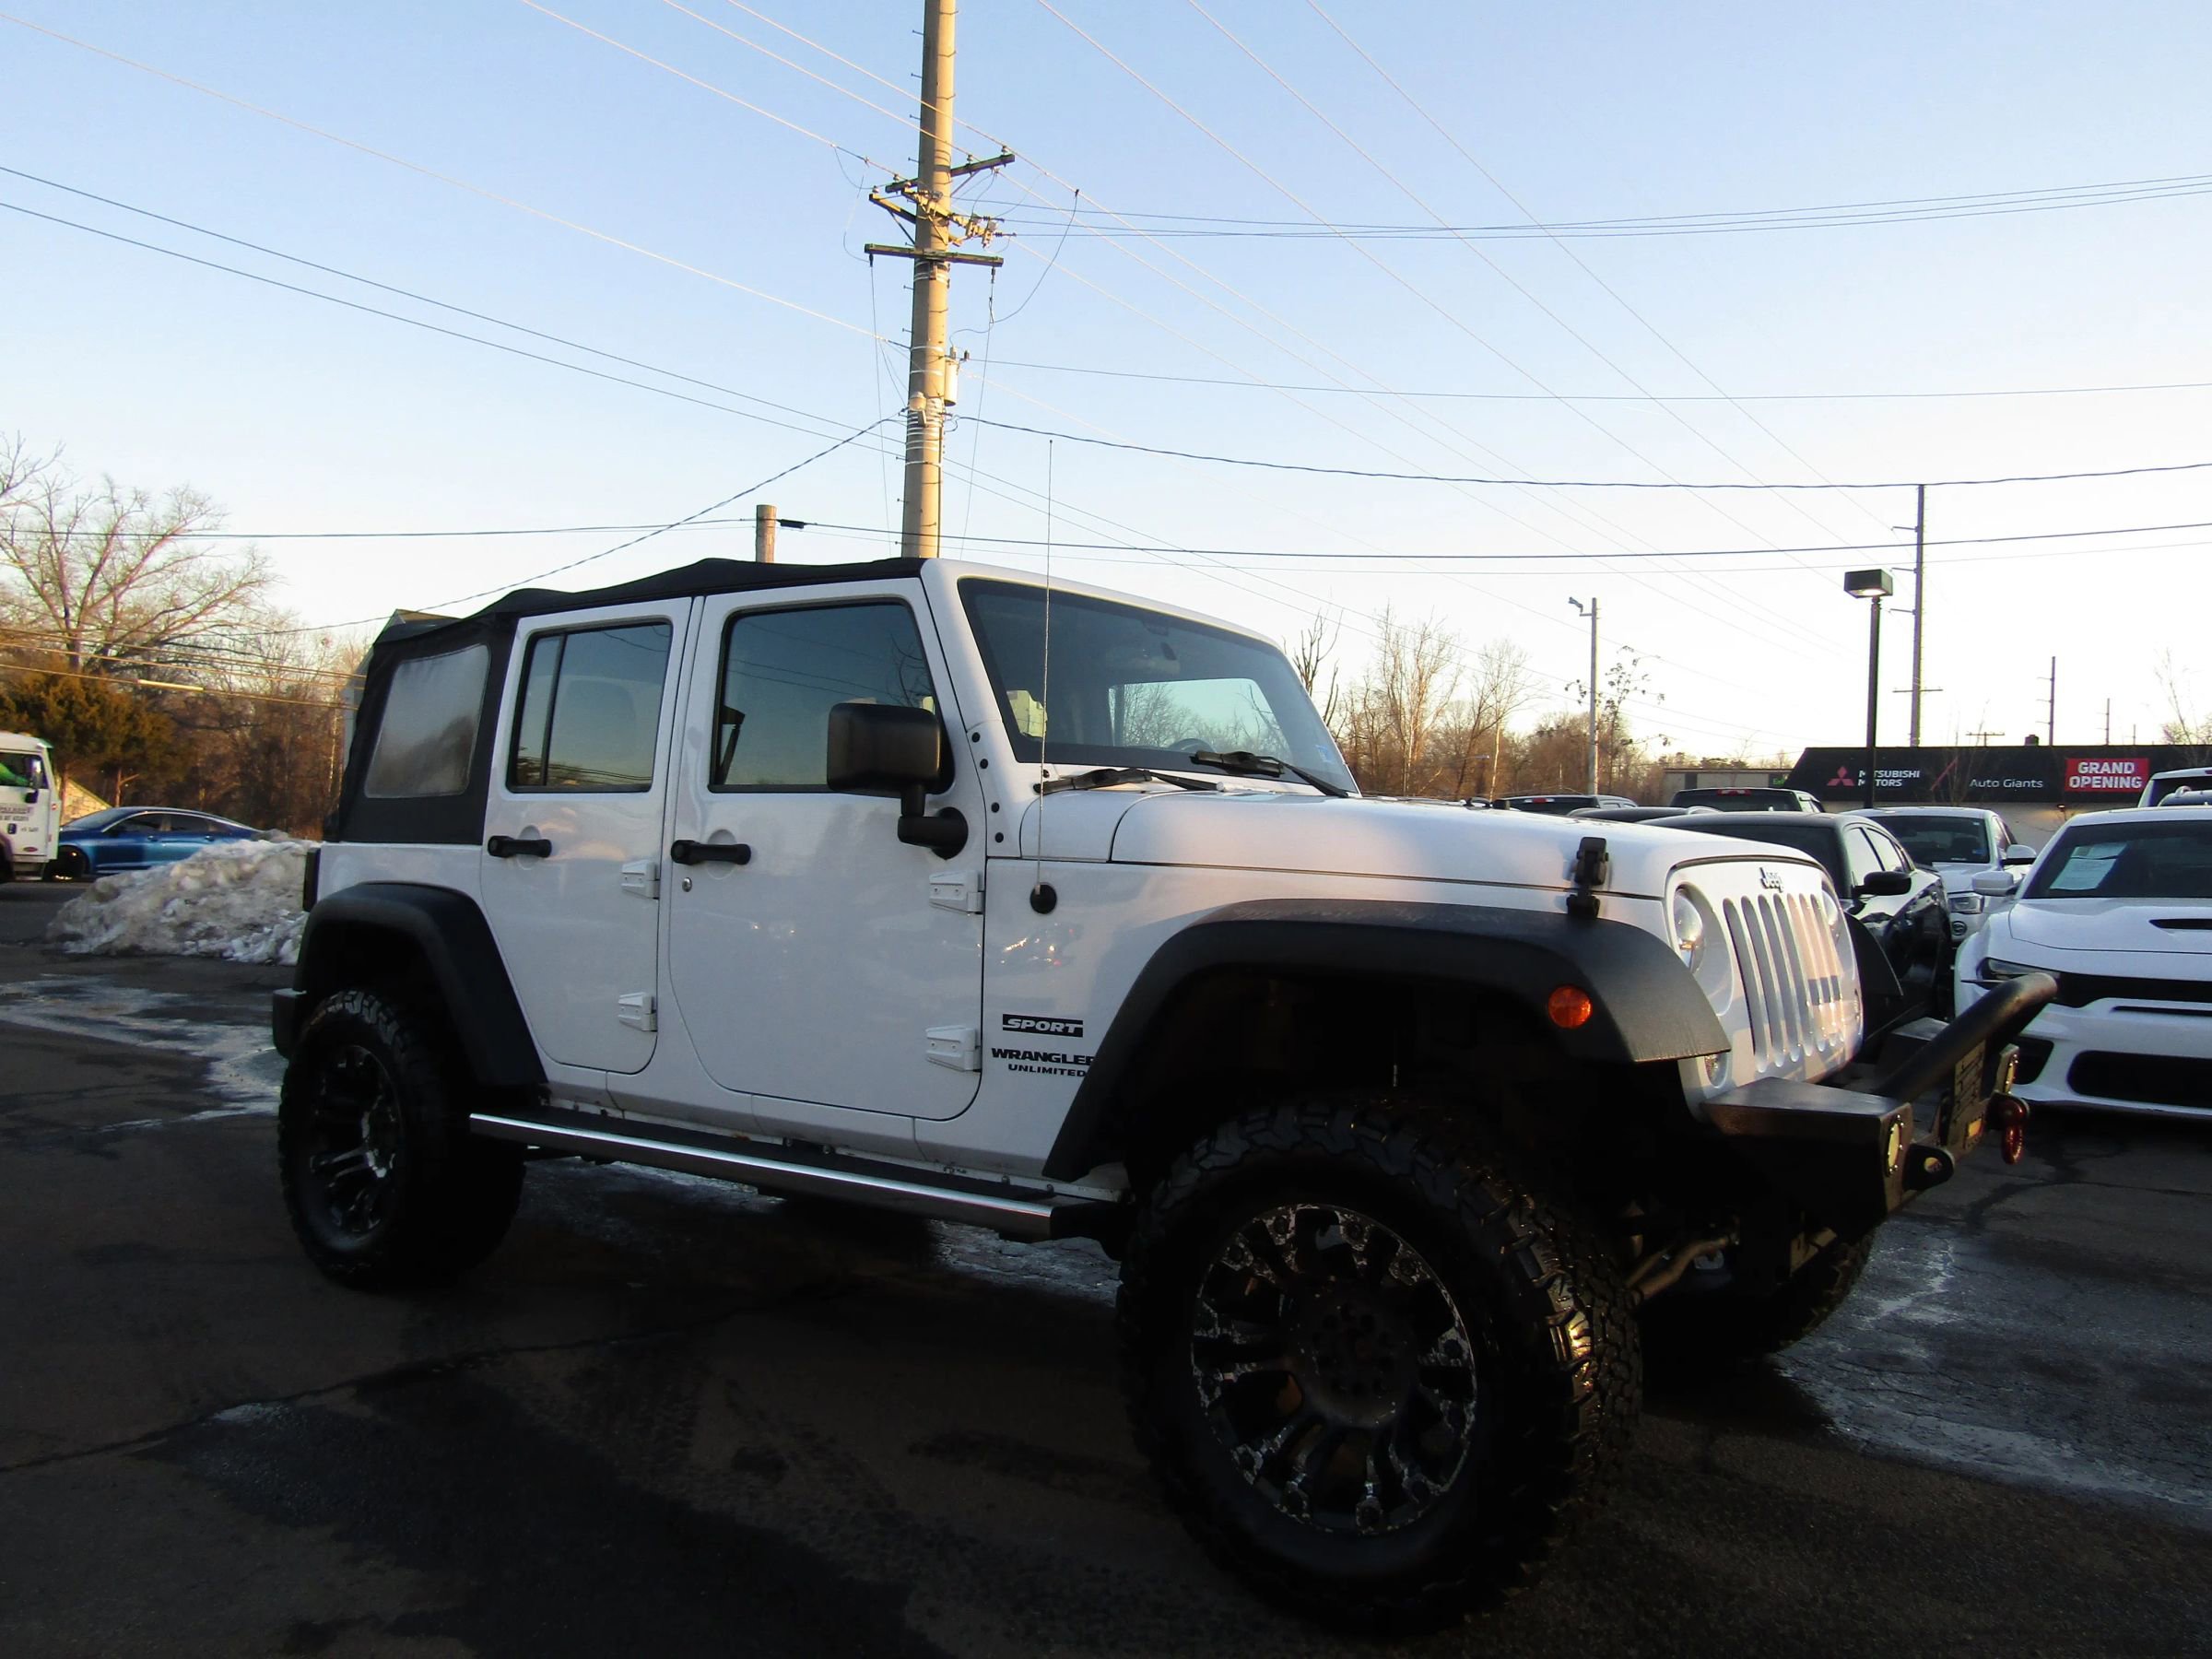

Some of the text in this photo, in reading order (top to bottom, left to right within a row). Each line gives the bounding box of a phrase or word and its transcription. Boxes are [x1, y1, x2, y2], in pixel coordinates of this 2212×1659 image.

[1858, 770, 1921, 778] MTSUBISHI
[2077, 761, 2136, 774] GRAND
[1857, 779, 1903, 787] MTORS
[1969, 779, 2043, 788] Auto Giants
[2068, 775, 2143, 788] OPENING
[1003, 1018, 1083, 1034] SPORT
[1007, 1064, 1087, 1077] UNLIMITED
